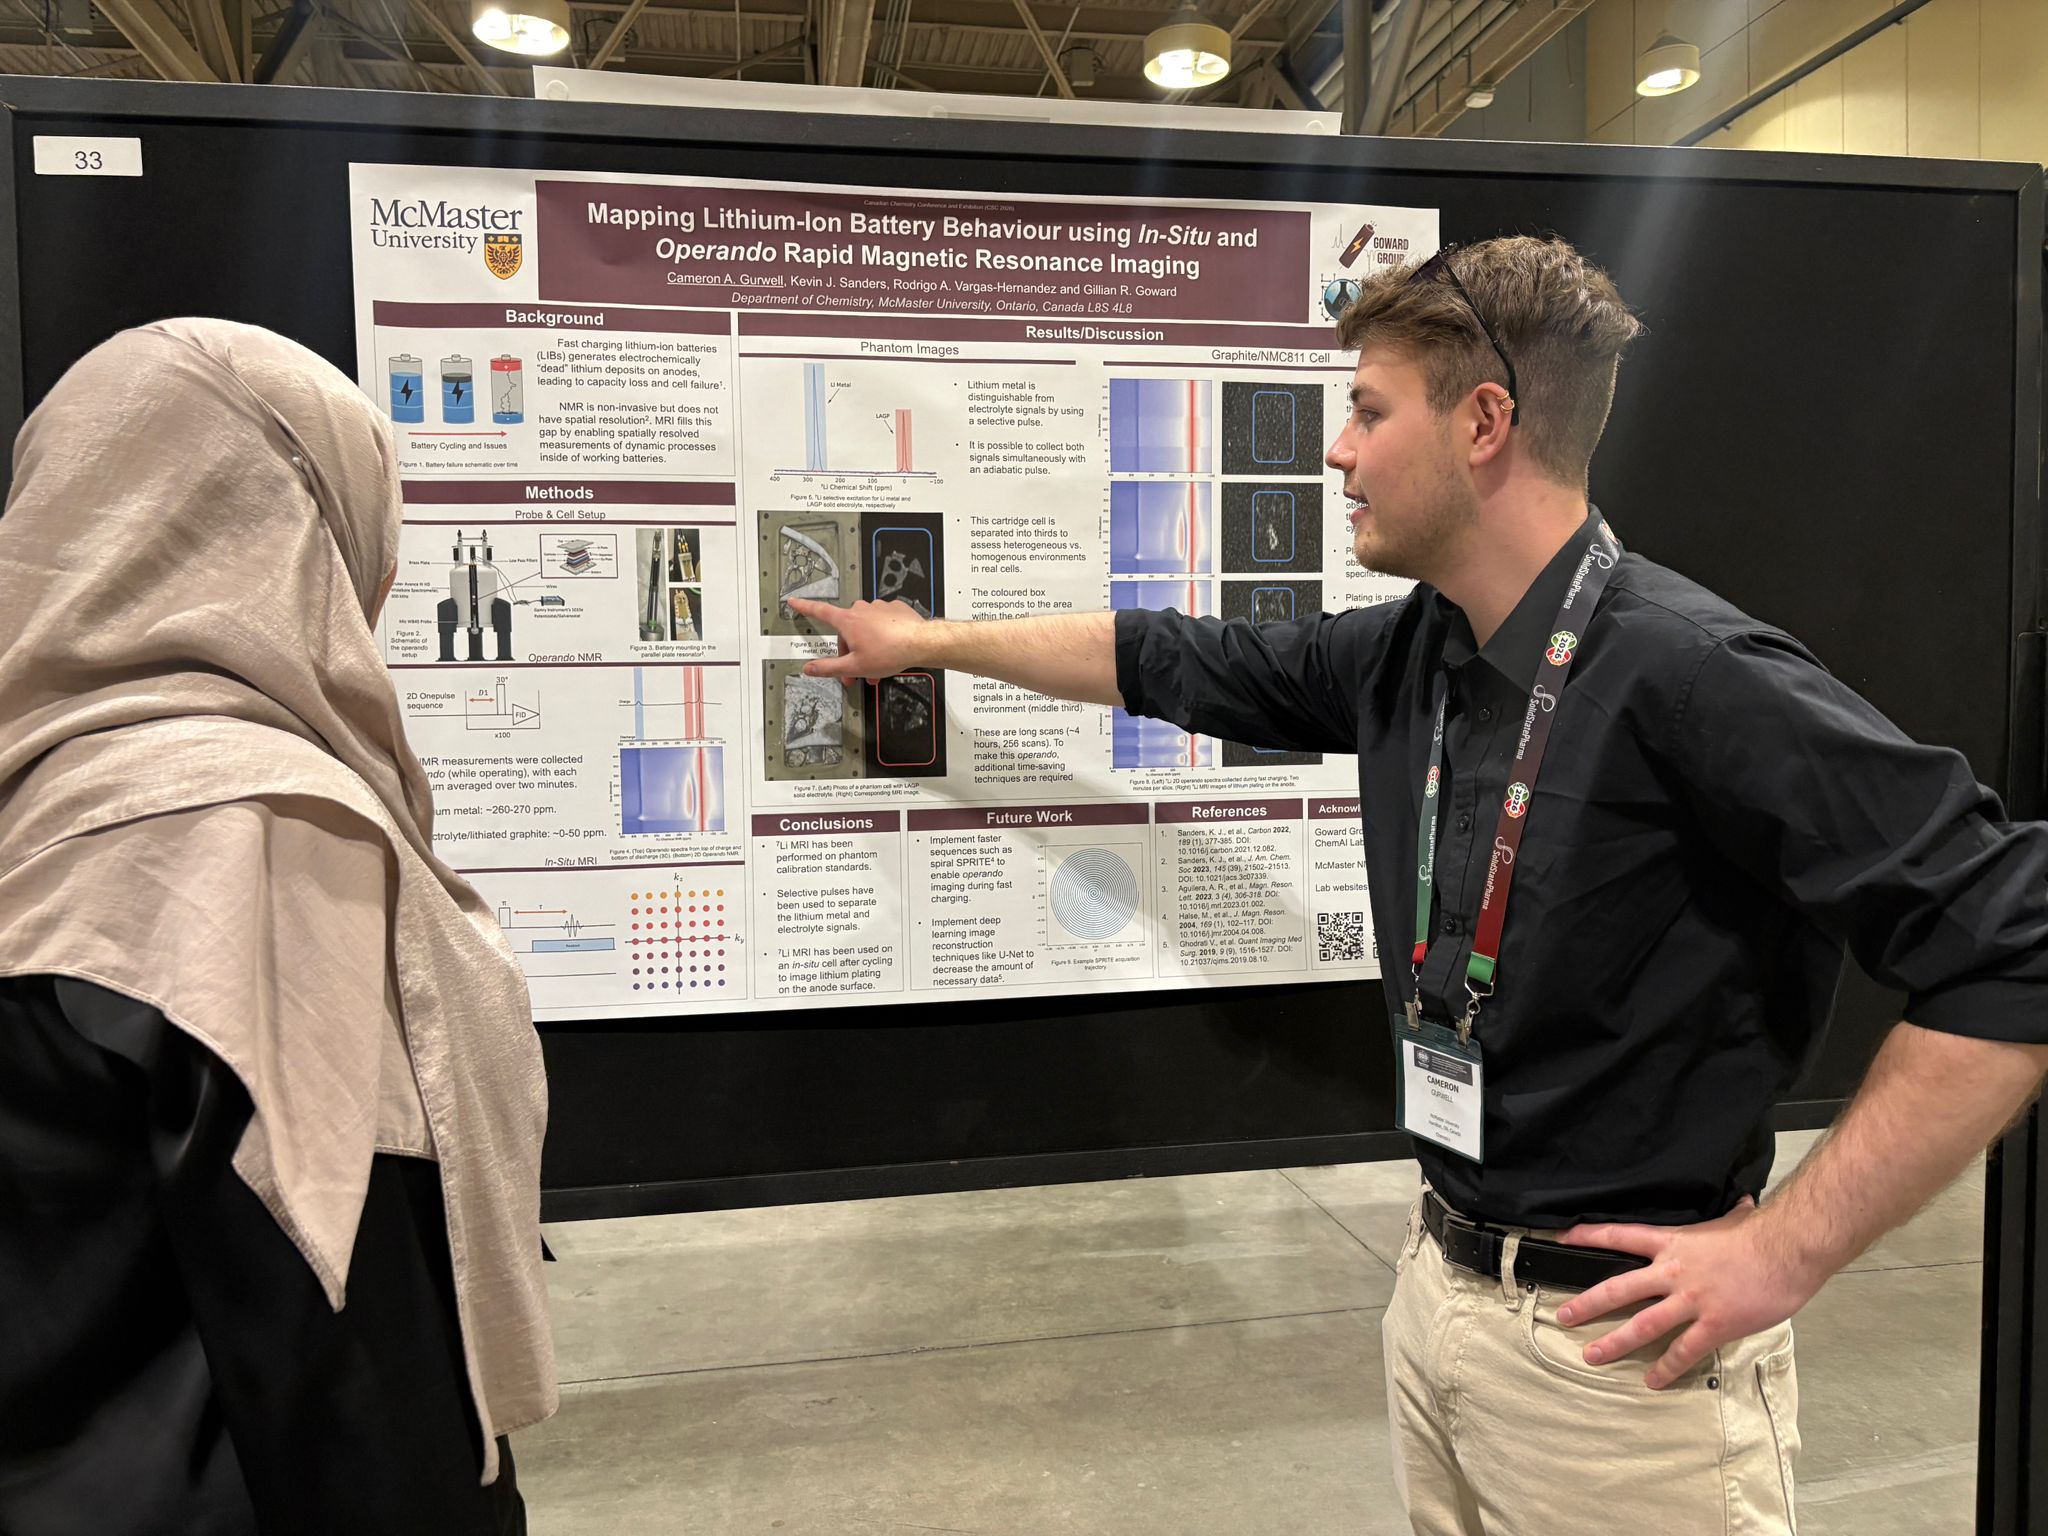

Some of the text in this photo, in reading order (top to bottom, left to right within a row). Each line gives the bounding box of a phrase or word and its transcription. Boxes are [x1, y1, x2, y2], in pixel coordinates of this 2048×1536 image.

[74, 150, 102, 170] 33
[370, 198, 522, 230] McMaster
[587, 202, 1257, 248] Mapping Lithium-Ion Battery Behaviour using In-Situ and
[370, 229, 478, 254] University
[1374, 237, 1408, 250] GOWARD
[655, 237, 1199, 280] Operando Rapid Magnetic Resonance Imaging
[1377, 252, 1405, 264] GROUP
[667, 272, 1176, 296] Cameron A. Gurwell, Kevin J. Sanders, Rodrigo A. Vargas-Hernandez and Gillian R. Goward
[731, 291, 1132, 313] Department of Chemistry, McMaster University, Ontario, Canada L8S 4L8
[505, 309, 603, 326] Background
[1026, 325, 1163, 340] Results/Discussion
[557, 338, 717, 353] Fast charging lithium-ion batteries
[860, 341, 959, 357] Phantom Images
[536, 350, 701, 366] (LIBs) generates electrochemically
[1211, 349, 1330, 363] Graphite/NMC811 Cell
[570, 363, 602, 373] lithium
[604, 364, 645, 376] deposits
[662, 367, 700, 378] anodes,
[537, 376, 572, 388] leading
[574, 377, 584, 386] to
[586, 377, 626, 388] capacity
[628, 377, 648, 387] loss
[650, 378, 669, 387] and
[671, 379, 687, 388] cell
[967, 380, 1036, 390] Lithium metal is
[967, 392, 1054, 403] distinguishable from
[968, 404, 1084, 417] electrolyte signals by using
[976, 416, 1015, 426] selective
[1017, 417, 1043, 427] pulse.
[410, 441, 438, 451] Battery
[439, 441, 466, 451] Cycling
[525, 485, 594, 499] Methods
[515, 510, 606, 520] Probe & Cell Setup
[1563, 554, 1595, 610] SolidStatePharma
[1555, 637, 1568, 659] 2026
[528, 653, 575, 663] Operando
[419, 692, 455, 700] Onepulse
[972, 728, 1000, 737] These
[1018, 727, 1037, 737] long
[1516, 698, 1539, 760] SolidStatePharma
[973, 737, 1064, 749] hours, 256 scans). To
[973, 749, 1059, 761] make this operando,
[974, 762, 1065, 772] additional time-saving
[974, 774, 1021, 784] techniques
[1038, 772, 1073, 783] required
[1512, 789, 1522, 811] 2026
[1192, 805, 1267, 818] References
[1319, 804, 1360, 814] Acknowl
[986, 809, 1072, 824] Future Work
[779, 816, 873, 831] Conclusions
[1314, 827, 1346, 836] Goward
[790, 840, 809, 849] MRI
[811, 840, 828, 848] has
[830, 839, 853, 848] been
[929, 834, 1002, 846] Implement faster
[544, 856, 597, 866] In-Situ MRI
[776, 851, 822, 864] performed
[838, 850, 877, 861] phantom
[776, 862, 872, 874] calibration standards.
[1482, 850, 1500, 910] SolidStatePharma
[1315, 882, 1367, 892] Lab websites
[1427, 1075, 1459, 1093] CAMERON
